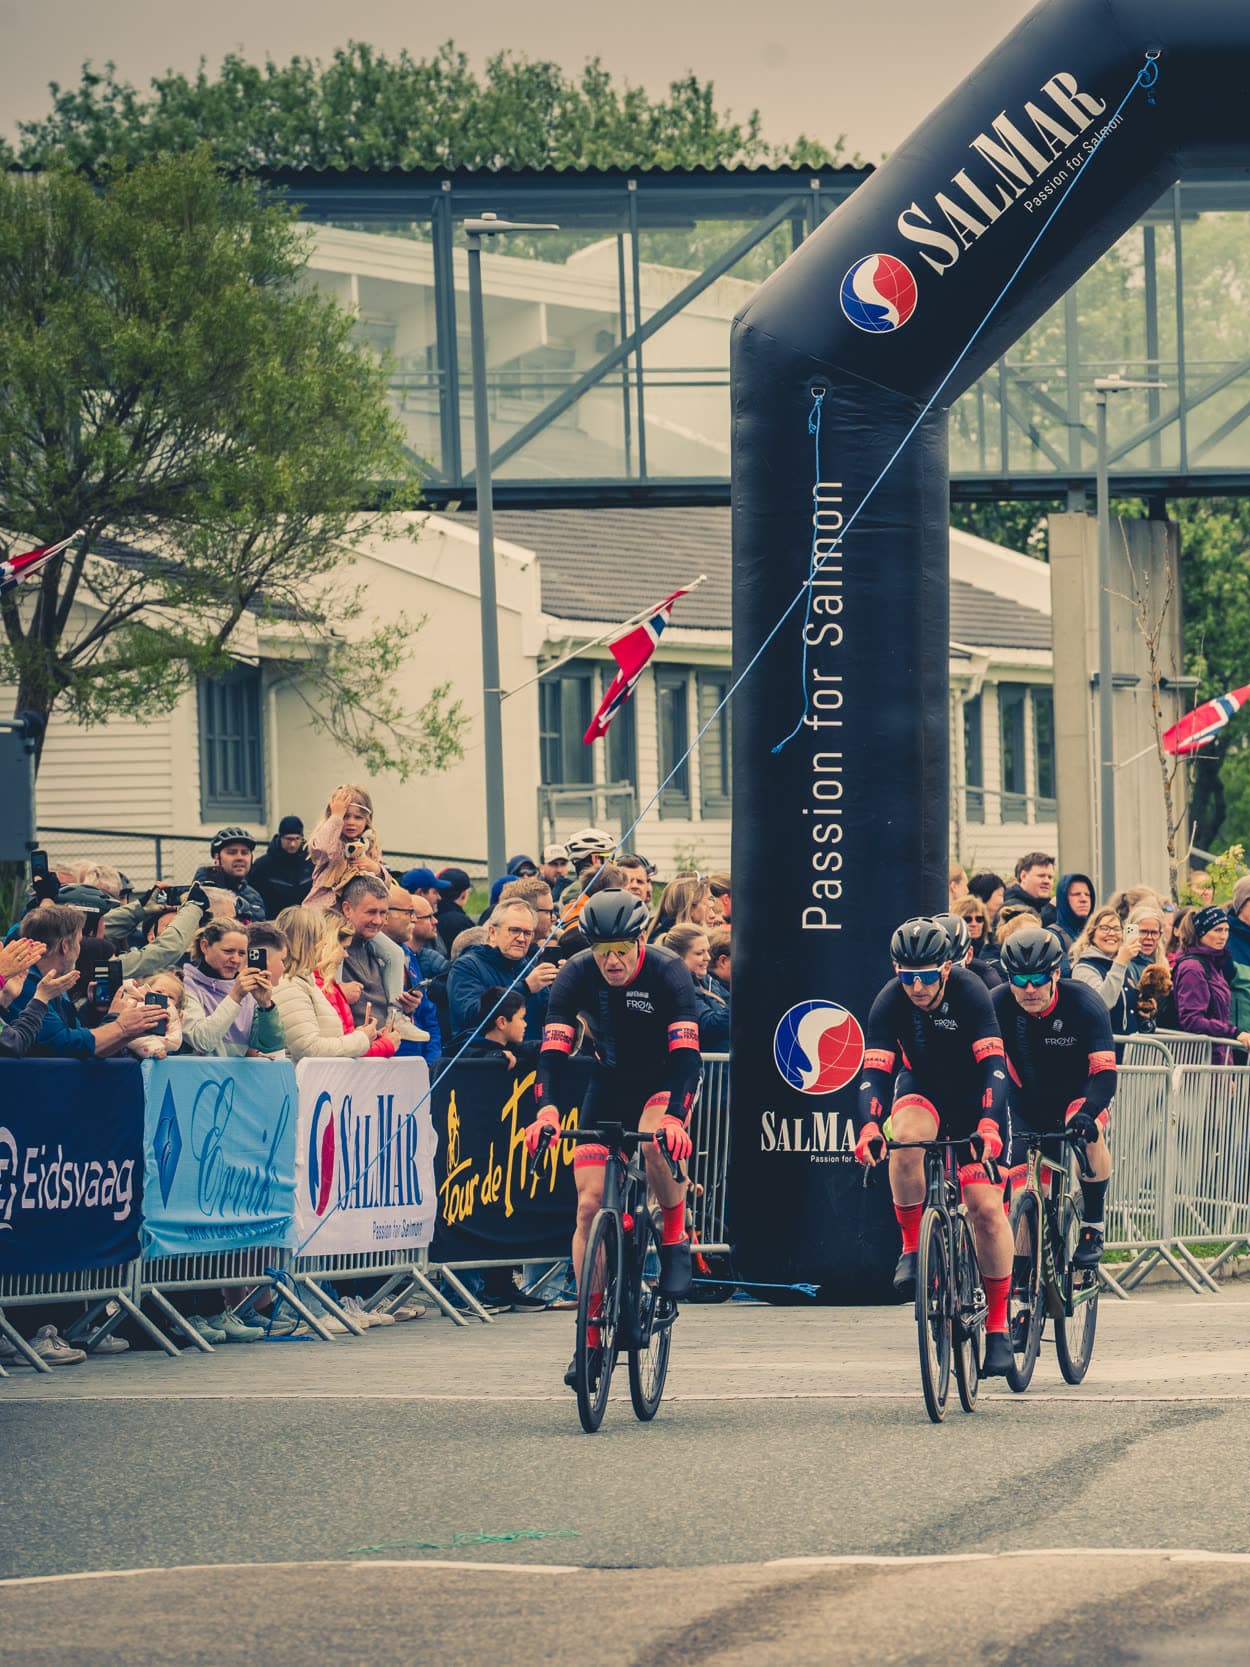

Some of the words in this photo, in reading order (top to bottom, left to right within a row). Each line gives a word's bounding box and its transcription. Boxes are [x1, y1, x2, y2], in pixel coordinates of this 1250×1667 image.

[897, 72, 1106, 276] SALMAR
[1023, 170, 1069, 213] Passion
[1065, 152, 1085, 171] for
[1082, 114, 1124, 153] Salmon
[802, 481, 843, 648] Salmon
[803, 668, 843, 731] for
[802, 752, 843, 930] Passion
[338, 1094, 423, 1211] SALMAR
[761, 1110, 857, 1152] SALMA
[810, 1154, 840, 1163] Passion
[841, 1154, 852, 1163] for
[22, 1144, 135, 1221] Eidsvaag
[439, 1157, 480, 1227] Tour
[480, 1141, 503, 1206] de
